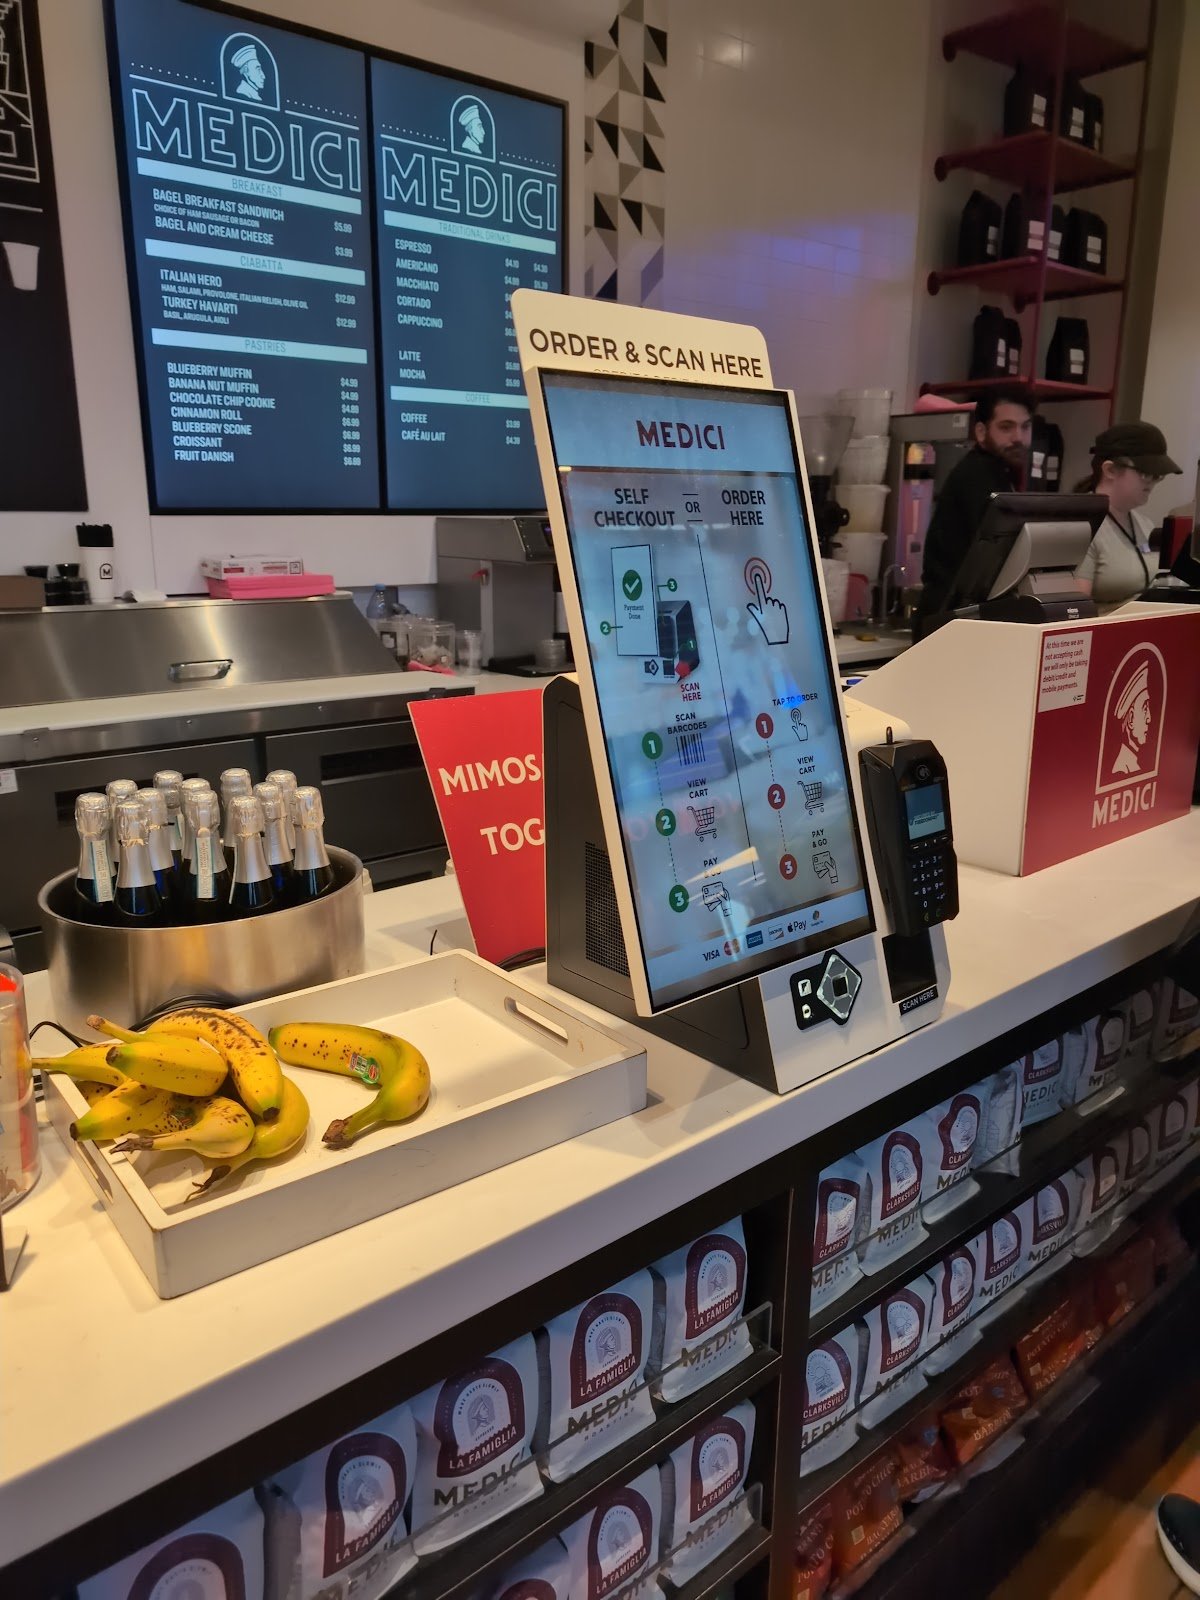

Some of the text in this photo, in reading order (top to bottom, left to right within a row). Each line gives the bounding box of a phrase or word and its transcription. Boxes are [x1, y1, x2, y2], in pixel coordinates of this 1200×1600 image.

[132, 88, 362, 193] MEDICI
[231, 178, 283, 198] BREAKFAST
[382, 146, 557, 231] MEDICI
[152, 188, 285, 222] BAGEL BREAKFAST SANDWICH
[153, 203, 178, 214] CHOICE
[178, 207, 187, 216] OF
[186, 208, 202, 218] HAM
[202, 211, 230, 223] SAUSAGE
[154, 215, 274, 245] BAGEL AND CREAM CHEESE
[439, 222, 511, 244] TRADITIONAL DRINKS
[395, 238, 432, 254] ESPRESSO
[240, 255, 284, 272] CIABATTA
[395, 257, 438, 273] AMERICANO
[160, 268, 223, 288] ITALIAN HERO
[396, 276, 439, 292] MACCHIATO
[161, 295, 238, 315] TURKEY HAVARTI
[397, 295, 431, 309] CORTADO
[398, 313, 443, 329] CAPPUCCINO
[244, 338, 286, 353] PASTRIES
[399, 350, 421, 362] LATTE
[529, 328, 618, 361] ORDER
[625, 341, 641, 364] &
[645, 343, 706, 372] SCAN
[711, 352, 764, 379] HERE
[167, 362, 253, 379] BLUEBERRY MUFFIN
[400, 368, 426, 380] MOCHA
[168, 377, 260, 394] BANANA NUT MUFFIN
[169, 392, 276, 409] CHOCOLATE CHIP COOKIE
[465, 392, 491, 404] COFFEE
[170, 406, 243, 421] CINNAMON ROLL
[401, 412, 428, 424] COFFEE
[172, 421, 253, 435] BLUEBERRY SCONE
[401, 428, 446, 441] CAFÉ AU LAIT
[636, 420, 726, 450] MEDICI
[173, 435, 223, 448] CROISSANT
[174, 449, 234, 463] FRUIT DANISH
[614, 488, 766, 513] SELF OR ORDER
[594, 510, 764, 527] CHECKOUT HERE
[103, 568, 110, 576] M
[623, 604, 644, 612] Payment
[1045, 642, 1051, 650] At
[1053, 651, 1073, 660] accepting
[1059, 662, 1068, 670] only
[1074, 659, 1088, 668] taking
[1042, 672, 1068, 683] debit/credit
[680, 682, 700, 693] SCAN
[1041, 685, 1056, 694] mobile
[682, 691, 702, 702] HERE
[772, 697, 785, 706] TAP
[796, 693, 818, 703] ORDER
[675, 712, 696, 722] SCAN
[667, 721, 707, 735] BARCODES
[797, 755, 814, 765] VIEW
[437, 753, 542, 796] MIMOS
[799, 765, 816, 775] CART
[687, 778, 707, 788] VIEW
[689, 788, 708, 799] CART
[772, 790, 781, 804] 2
[1092, 781, 1157, 829] MEDICI
[661, 815, 671, 830] 2
[479, 817, 545, 856] TOG
[812, 829, 824, 839] PAY
[818, 837, 827, 846] GO
[703, 857, 718, 867] PAY
[675, 891, 685, 906] 3
[793, 920, 807, 931] Pay
[702, 949, 720, 962] VISA
[902, 989, 935, 1011] SCAN HERE
[886, 1181, 920, 1211] CLARKSVILLE
[694, 1291, 739, 1330] LA FAMIGLIA
[580, 1355, 637, 1397] LA FAMIGLIA
[803, 1389, 848, 1419] CLARKSVILLE
[449, 1425, 517, 1470] LA FAMIGLIA
[697, 1470, 741, 1511] LA FAMIGLIA
[335, 1500, 400, 1564] LA FAMIGLIA
[596, 1582, 607, 1594] LA
[610, 1546, 647, 1584] FAMIGLIA
